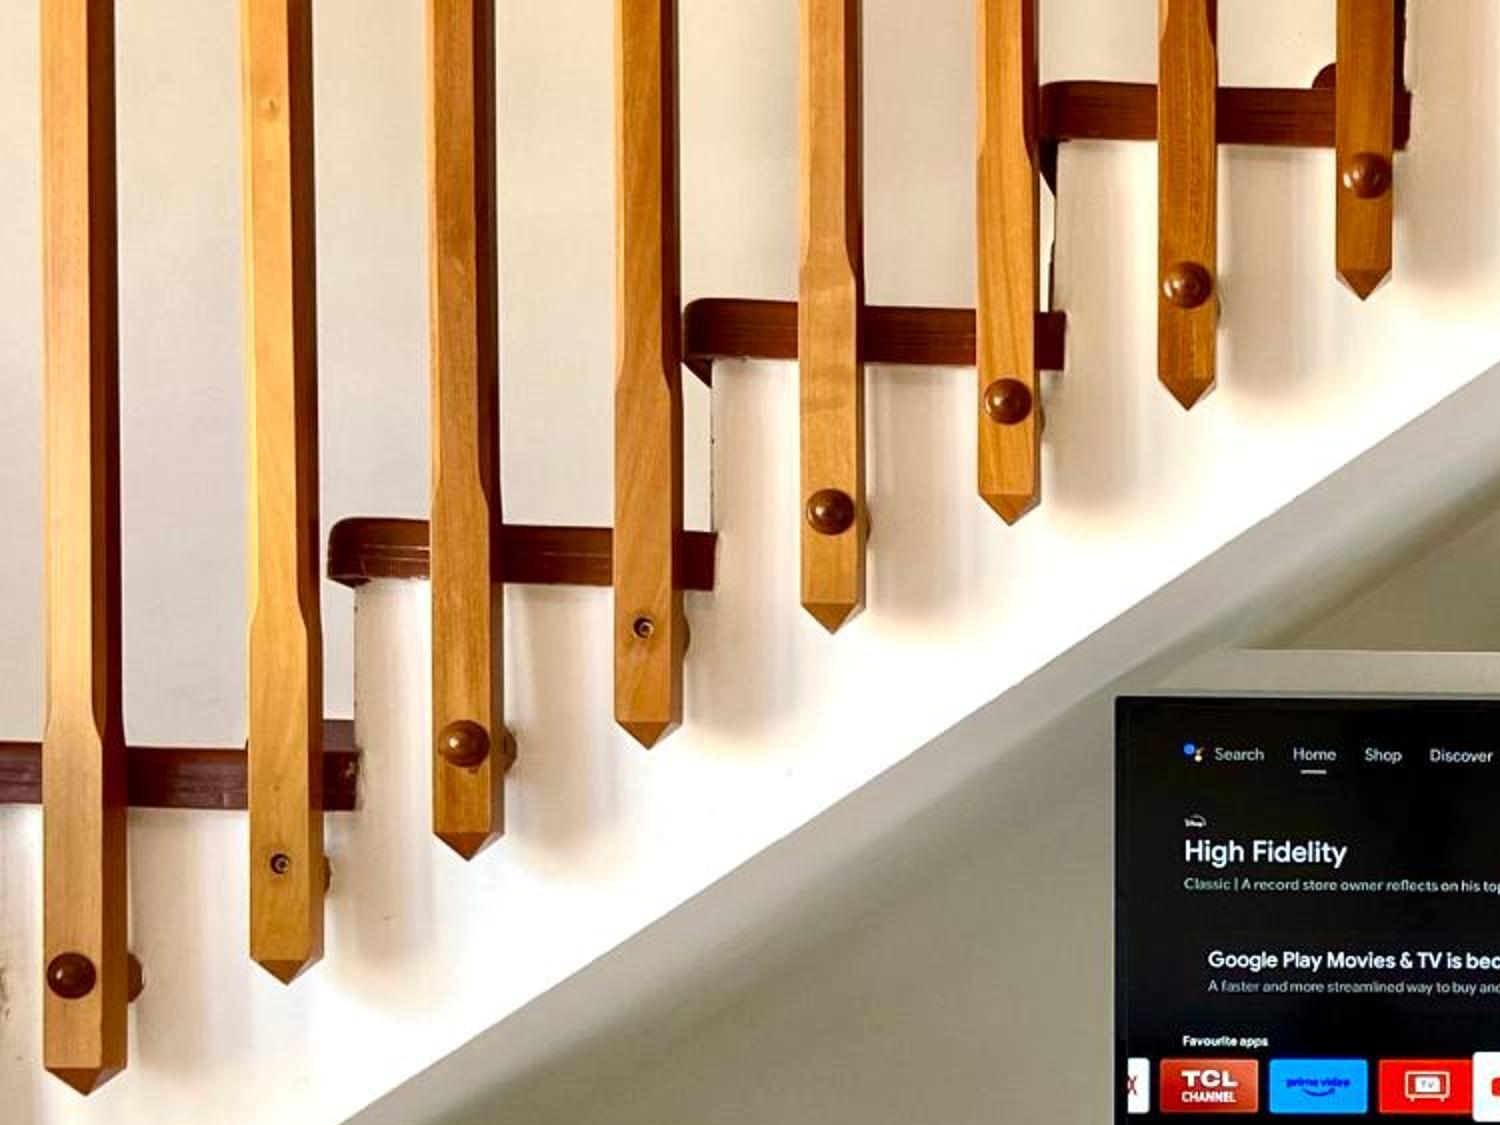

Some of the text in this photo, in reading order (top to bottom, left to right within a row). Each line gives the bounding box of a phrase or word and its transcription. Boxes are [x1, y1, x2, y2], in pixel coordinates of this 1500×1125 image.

[1215, 748, 1264, 761] Search
[1293, 747, 1337, 761] Home
[1365, 748, 1402, 764] Shop
[1429, 748, 1494, 763] Discover
[1185, 839, 1348, 869] High Fidelity
[1183, 878, 1230, 891] Classic
[1241, 878, 1251, 891] A
[1254, 878, 1299, 891] record
[1302, 879, 1337, 892] store
[1340, 881, 1383, 892] owner
[1386, 879, 1438, 892] reflects
[1440, 881, 1459, 893] on
[1461, 880, 1481, 893] his
[1207, 950, 1278, 973] Google
[1283, 951, 1323, 973] Play
[1327, 951, 1396, 969] Movies
[1399, 951, 1413, 969] &
[1417, 952, 1443, 969] TV
[1446, 951, 1462, 969] is
[1208, 980, 1219, 992] A
[1221, 979, 1259, 993] faster
[1262, 980, 1288, 993] and
[1290, 983, 1324, 993] more
[1327, 980, 1404, 993] streamlined
[1406, 983, 1433, 996] way
[1436, 982, 1450, 993] to
[1452, 982, 1476, 996] buy
[1183, 1036, 1269, 1049] Favourite apps
[1181, 1069, 1239, 1088] TCL
[1181, 1091, 1237, 1103] CHANNEL
